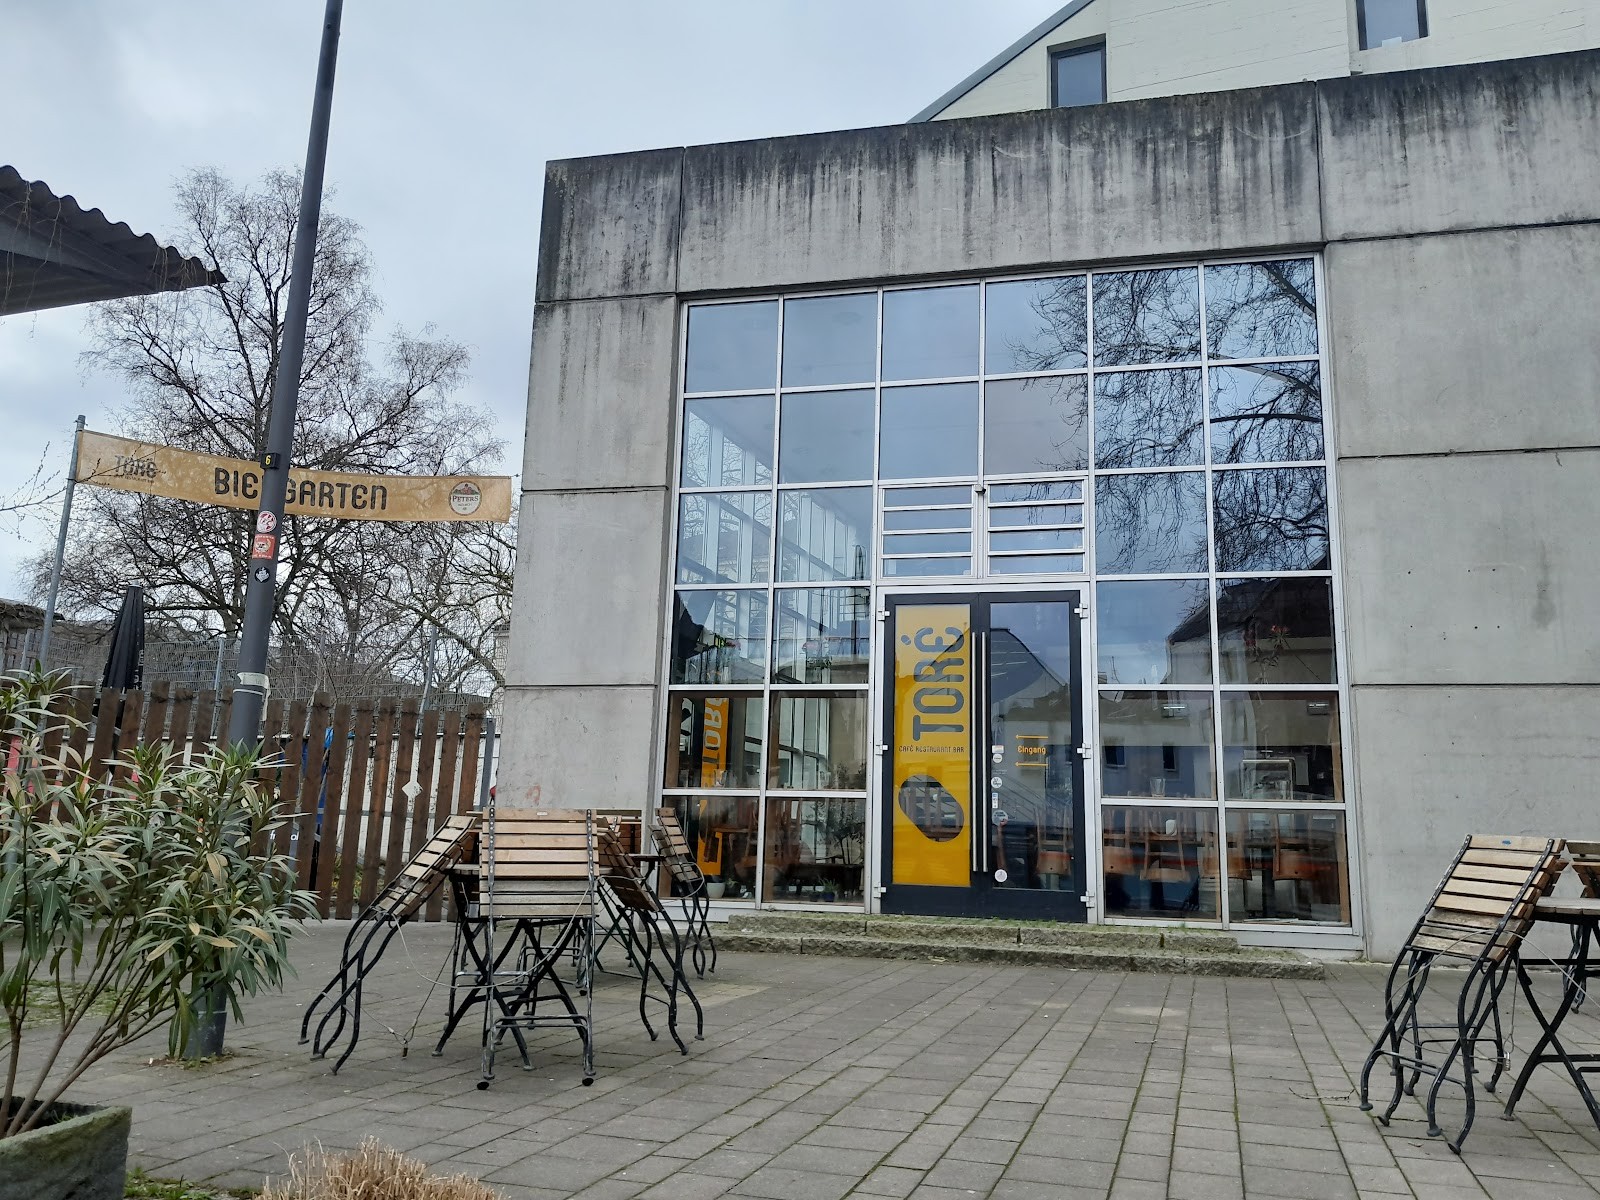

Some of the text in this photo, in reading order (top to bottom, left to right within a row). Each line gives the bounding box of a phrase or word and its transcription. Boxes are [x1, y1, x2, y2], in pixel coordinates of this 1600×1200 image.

[265, 455, 271, 465] 6
[214, 467, 388, 510] BIEGARTEN
[1017, 745, 1046, 755] Eingang
